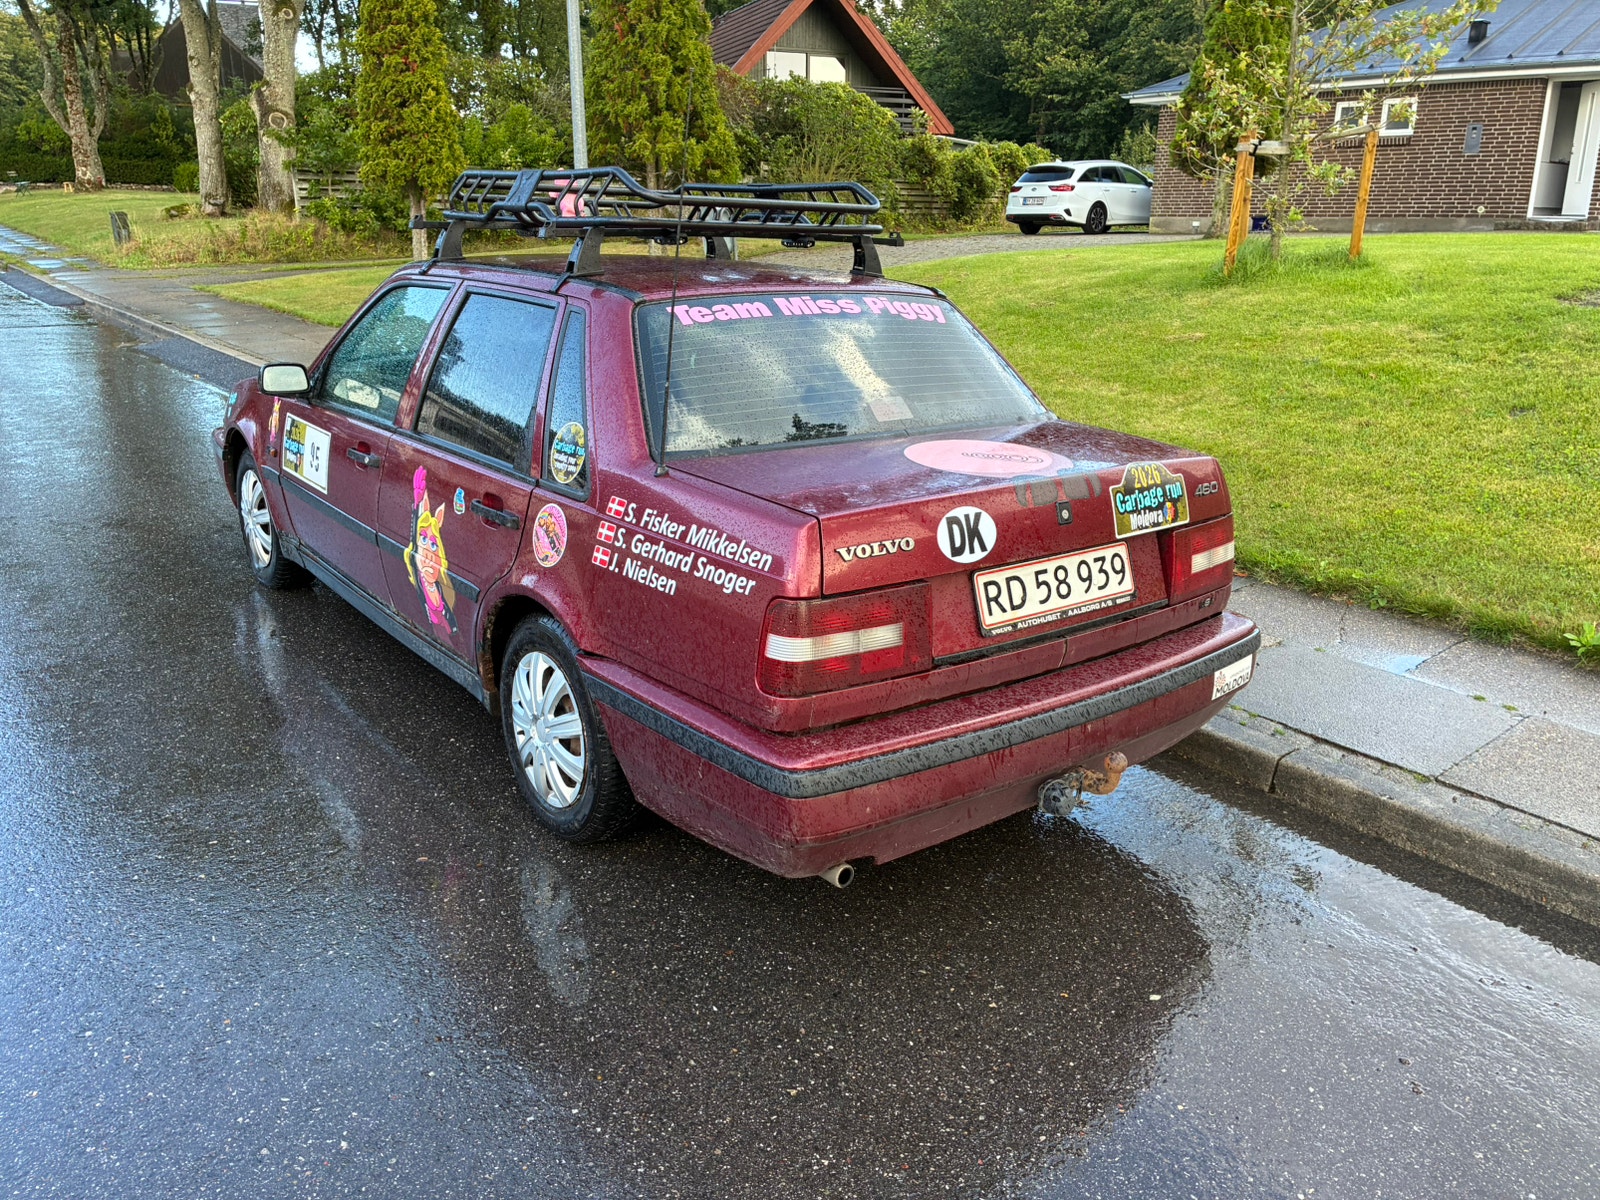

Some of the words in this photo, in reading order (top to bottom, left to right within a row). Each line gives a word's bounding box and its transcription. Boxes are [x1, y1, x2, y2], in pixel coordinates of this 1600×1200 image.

[666, 301, 773, 326] Team
[773, 296, 862, 316] Miss
[862, 297, 947, 324] Piggy
[1131, 464, 1161, 488] 2026
[1195, 481, 1218, 497] 460
[1116, 486, 1164, 513] Carbage
[1165, 481, 1182, 499] run
[946, 512, 988, 558] DK
[1130, 509, 1163, 530] Moldova
[624, 503, 637, 524] S.
[640, 508, 686, 540] Fisker
[685, 524, 773, 572] Mikkelsen
[837, 537, 915, 562] VOLVO
[609, 554, 619, 573] J.
[622, 558, 677, 595] Nielsen
[615, 528, 627, 549] S.
[631, 534, 694, 573] Gerhard
[694, 556, 756, 596] Snoger
[983, 575, 1027, 616] RD
[1034, 565, 1072, 605] 58
[1077, 552, 1126, 594] 939
[1017, 613, 1062, 629] AUTOHUSET
[1068, 604, 1100, 616] AALBORG
